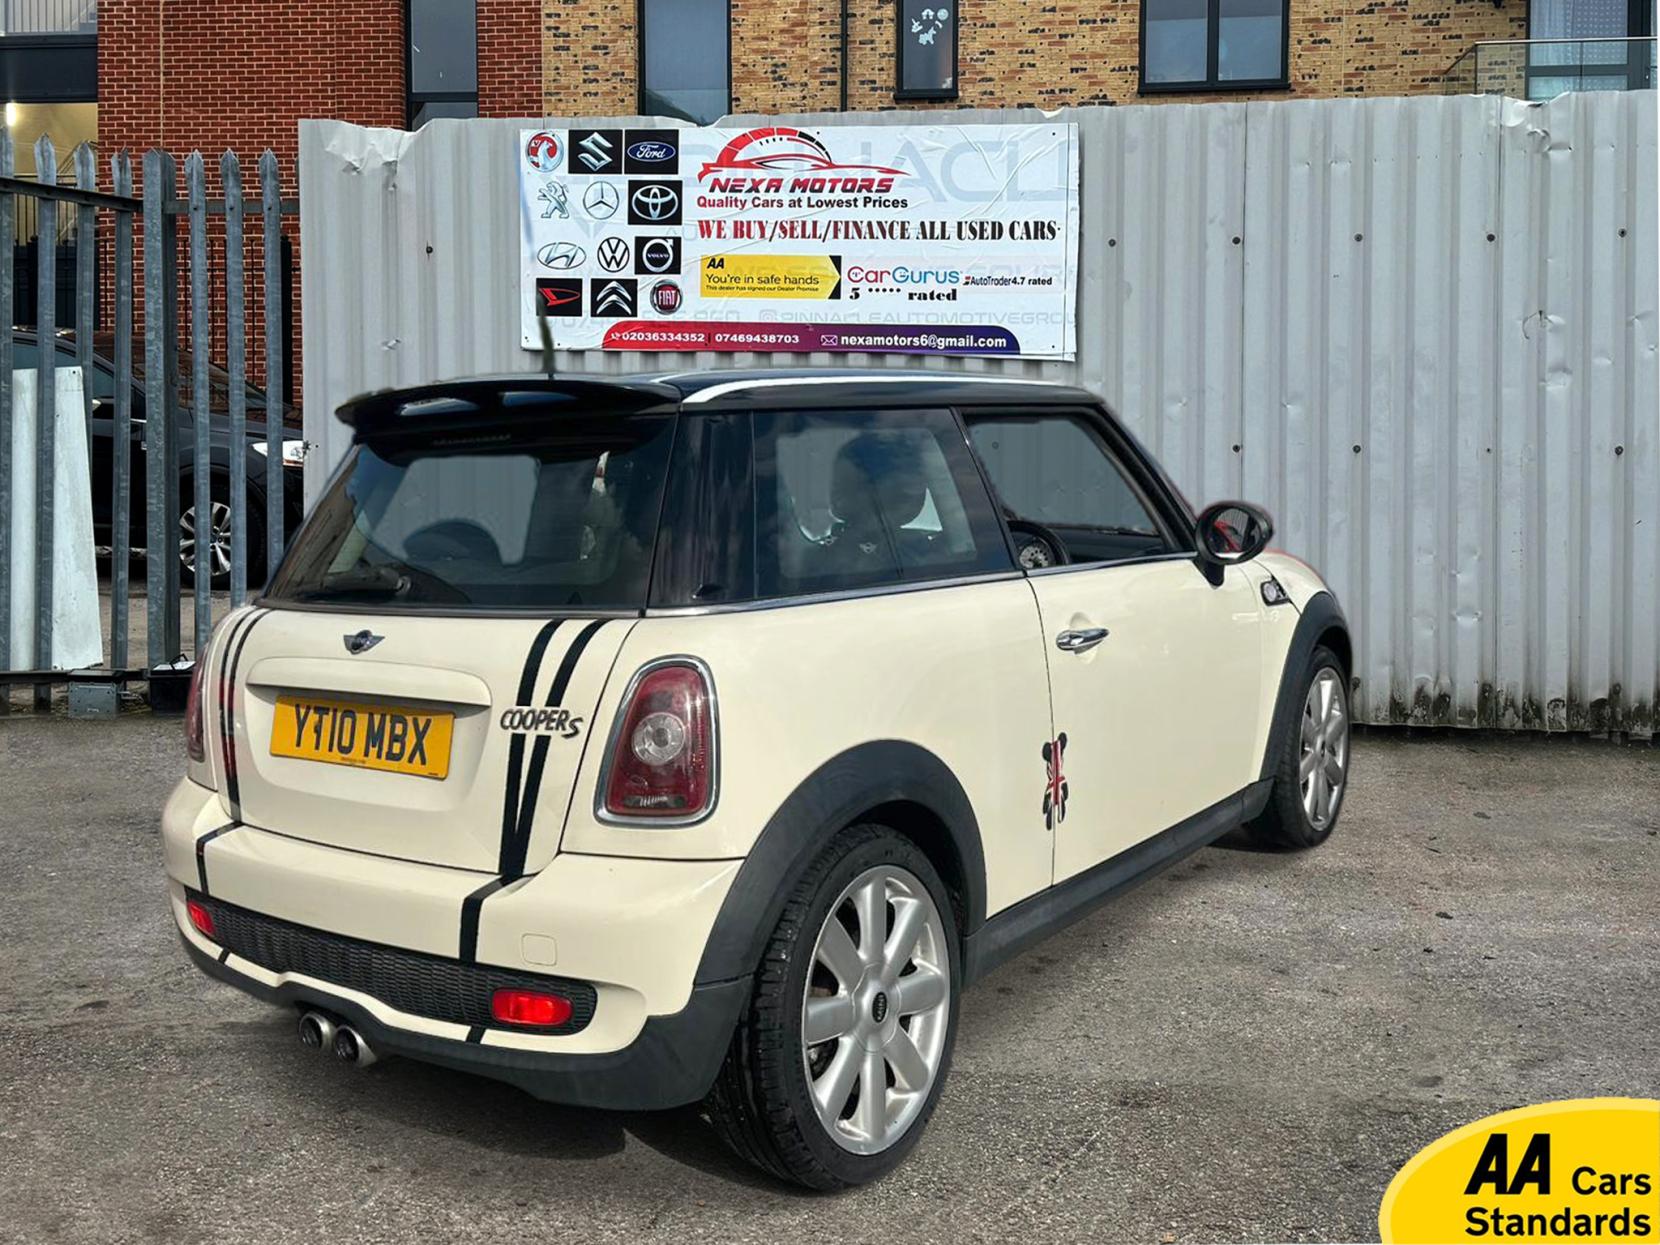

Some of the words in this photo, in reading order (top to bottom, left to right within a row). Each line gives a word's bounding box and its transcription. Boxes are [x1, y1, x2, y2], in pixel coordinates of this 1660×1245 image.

[636, 143, 666, 158] Ford
[708, 178, 783, 193] NEXA
[789, 178, 894, 193] MOTORS
[697, 195, 747, 210] Quality
[751, 196, 784, 208] Cars
[788, 197, 803, 208] at
[807, 196, 858, 208] Lowest
[863, 196, 908, 208] Prices
[698, 220, 727, 240] WE
[732, 220, 911, 243] BUY/SELL/FINANCE
[916, 220, 951, 240] ALL
[956, 220, 1004, 241] USED
[1008, 220, 1057, 241] CARS
[706, 258, 725, 269] AA
[706, 274, 741, 284] You're
[744, 274, 754, 284] in
[757, 274, 781, 285] safe
[784, 275, 819, 285] hands
[847, 266, 960, 284] CarGurus
[658, 290, 676, 305] FIAT
[849, 287, 861, 300] 5
[908, 288, 957, 301] rated
[621, 332, 706, 342] 02036334352
[715, 333, 799, 343] 07469438703
[841, 334, 1007, 348] nexamotors6@gmail.com
[500, 709, 570, 731] COOPER
[294, 703, 357, 753] YT10
[363, 713, 431, 766] MBX
